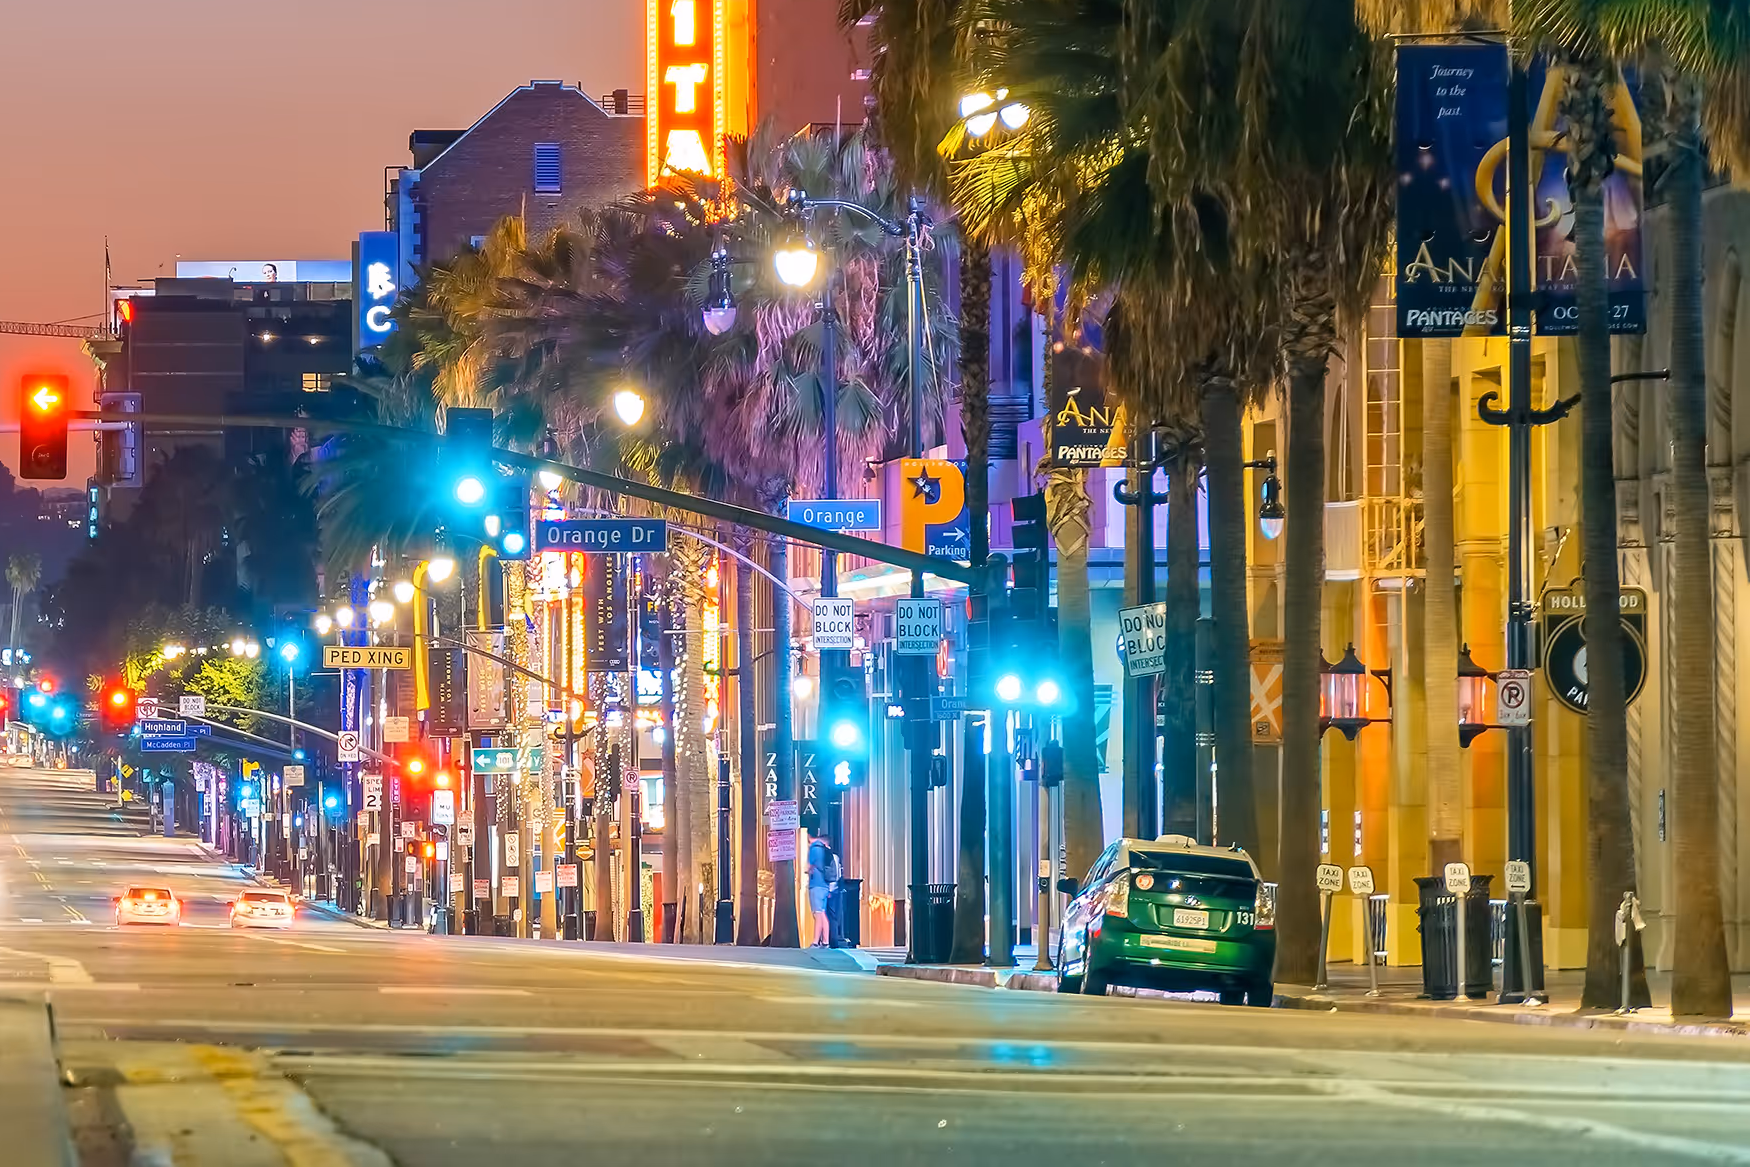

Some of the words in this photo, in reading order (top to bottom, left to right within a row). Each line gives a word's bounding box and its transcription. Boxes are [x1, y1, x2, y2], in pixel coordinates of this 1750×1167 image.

[1429, 64, 1475, 80] Journey
[1436, 85, 1448, 97] to
[1449, 85, 1467, 97] the
[1436, 105, 1463, 120] past.
[1537, 253, 1638, 282] TAIA
[1438, 285, 1458, 293] THE
[1406, 309, 1498, 326] PANTAGES
[1553, 306, 1579, 320] OC
[1607, 304, 1630, 319] -27
[1057, 445, 1128, 460] PANTAGES
[803, 508, 865, 527] Orange
[547, 526, 621, 548] Orange
[632, 526, 655, 543] Dr
[928, 544, 967, 558] Parking
[1551, 595, 1639, 609] HOLLOD
[815, 605, 828, 616] DO
[833, 605, 851, 616] NOT
[900, 607, 912, 619] DO
[919, 606, 938, 618] NOT
[815, 621, 851, 633] BLOCK
[1124, 616, 1142, 633] DO
[1145, 614, 1164, 629] NO
[900, 624, 939, 637] BLOCK
[815, 636, 851, 644] INTERSECTION
[1127, 635, 1165, 654] BLOC
[330, 650, 362, 664] PED
[368, 651, 404, 664] XING
[1130, 655, 1164, 670] INTERSEC
[941, 699, 966, 709] Oran
[144, 722, 182, 733] Highland
[146, 740, 181, 749] McCadden
[183, 740, 191, 748] Pl
[803, 753, 818, 815] ZARA
[366, 795, 377, 808] 2
[1321, 867, 1339, 877] TAXI
[1352, 870, 1368, 878] TAXI
[1449, 867, 1464, 876] TAXI
[1508, 864, 1524, 873] TAXI
[1319, 877, 1340, 887] ZONE
[1353, 880, 1371, 888] ZONE
[1448, 878, 1468, 887] ZONE
[1508, 874, 1526, 883] ZONE
[1237, 911, 1254, 926] 131
